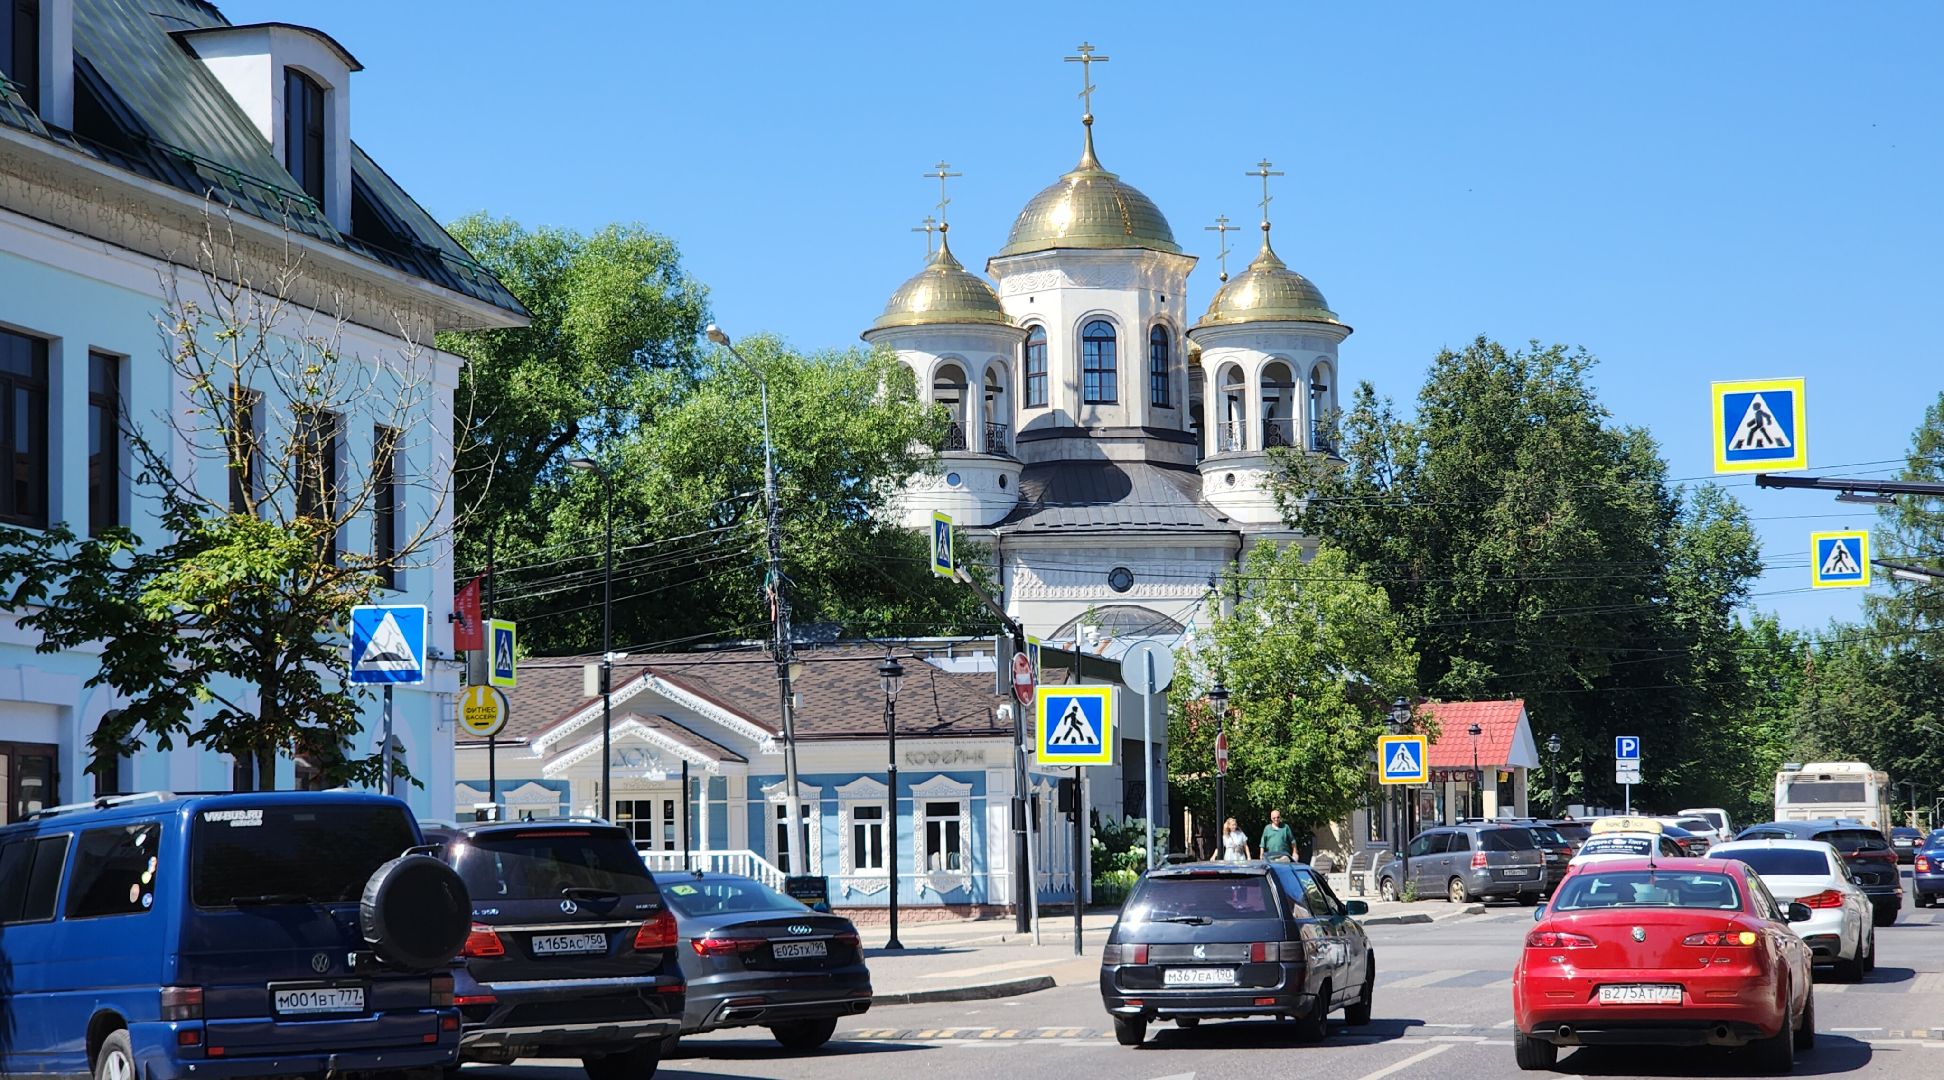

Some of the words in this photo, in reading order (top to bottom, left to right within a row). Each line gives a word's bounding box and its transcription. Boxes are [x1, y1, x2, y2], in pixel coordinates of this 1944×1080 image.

[465, 706, 497, 714] ФИТНЕС
[1622, 739, 1636, 757] P
[905, 748, 986, 768] КОФЕЙНЯ
[204, 810, 263, 822] VW-BUS.RU
[536, 937, 584, 951] А165АС
[584, 934, 604, 945] 750
[775, 944, 811, 957] Е025ТХ
[1168, 968, 1212, 982] М367ЕА
[279, 992, 336, 1008] М001ВТ
[338, 989, 360, 1002] 777
[1604, 985, 1655, 1000] В275АТ
[1657, 984, 1676, 997] 777
